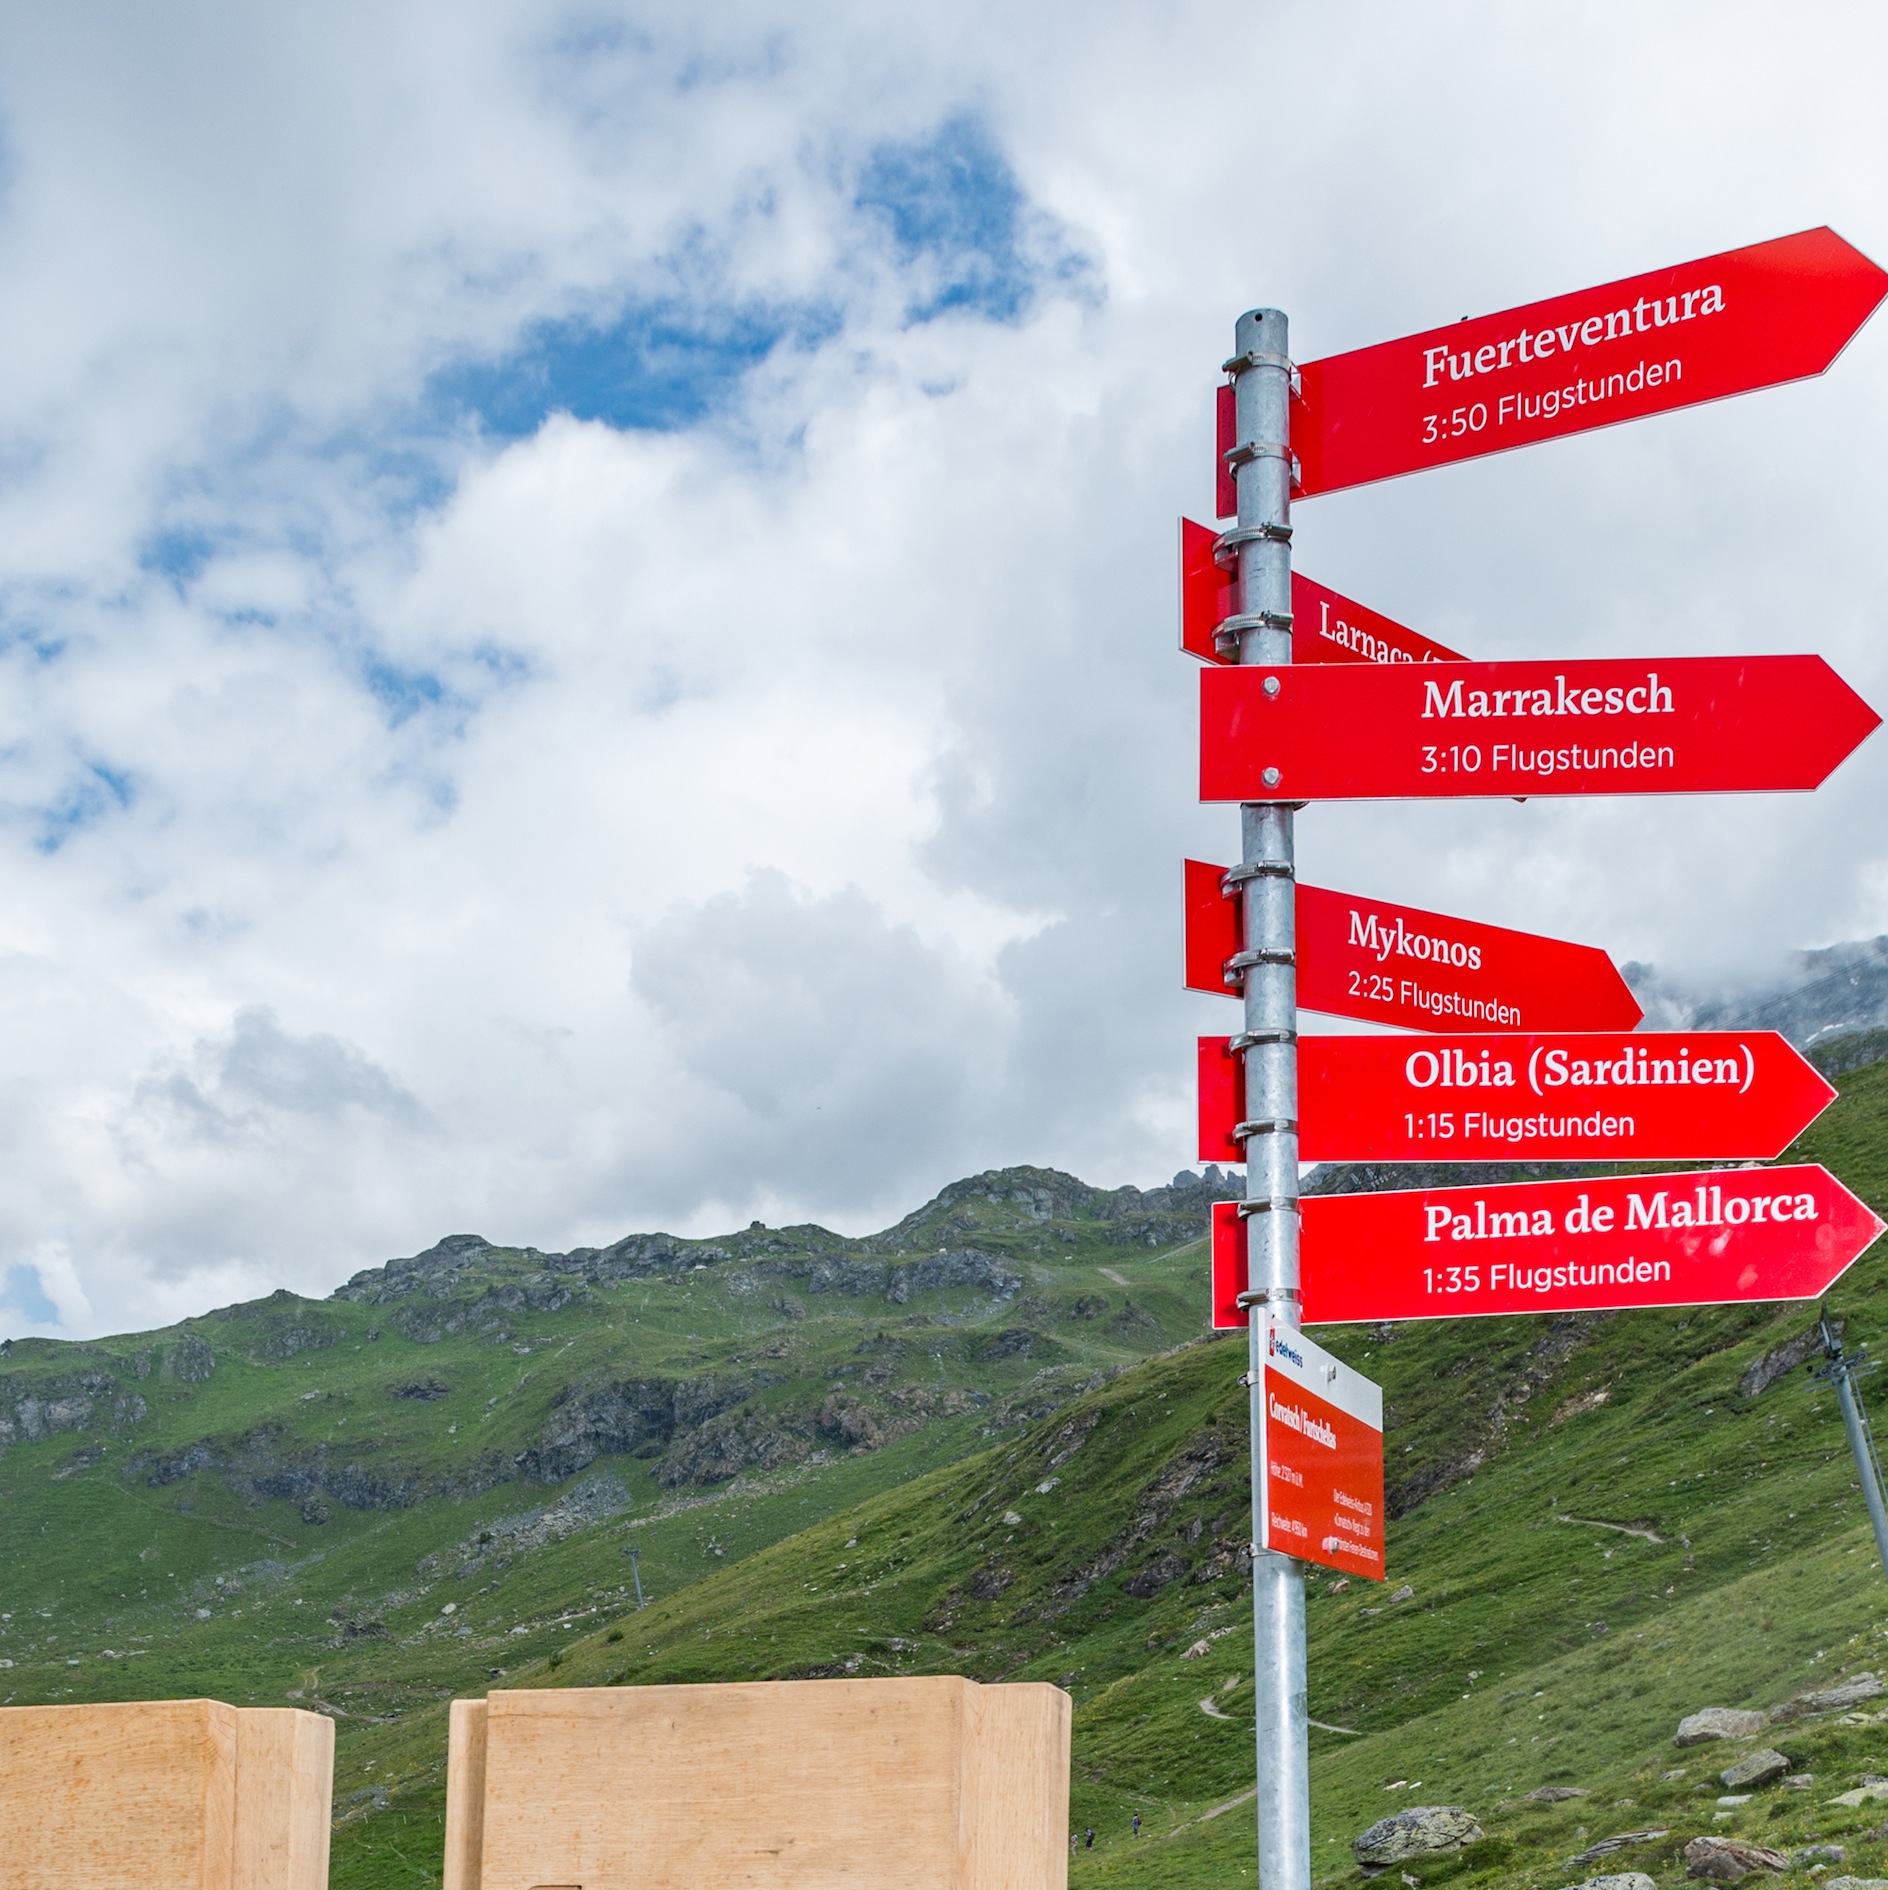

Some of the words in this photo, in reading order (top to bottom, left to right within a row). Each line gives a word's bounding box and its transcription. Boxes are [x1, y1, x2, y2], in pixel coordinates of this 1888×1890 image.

[1420, 282, 1726, 389] Fuerteventura
[1422, 403, 1488, 444] 3:50
[1497, 356, 1683, 426] Flugstunden
[1421, 672, 1675, 719] Marrakesch
[1421, 745, 1482, 773] 3:10
[1492, 740, 1674, 776] Flugstunden
[1347, 909, 1482, 971] Mykonos
[1348, 970, 1394, 1002] 2:25
[1400, 980, 1521, 1026] Flugstunden
[1405, 1048, 1517, 1088] Olbia
[1528, 1043, 1755, 1097] (Sardinien)
[1404, 1112, 1455, 1139] 1:15
[1464, 1110, 1635, 1143] Flugstunden
[1423, 1202, 1556, 1243] Palma
[1564, 1195, 1615, 1234] de
[1623, 1186, 1819, 1231] Mallorca
[1423, 1266, 1481, 1294] 1:35
[1490, 1256, 1671, 1293] Flugstunden
[1275, 1339, 1303, 1368] edelweiss
